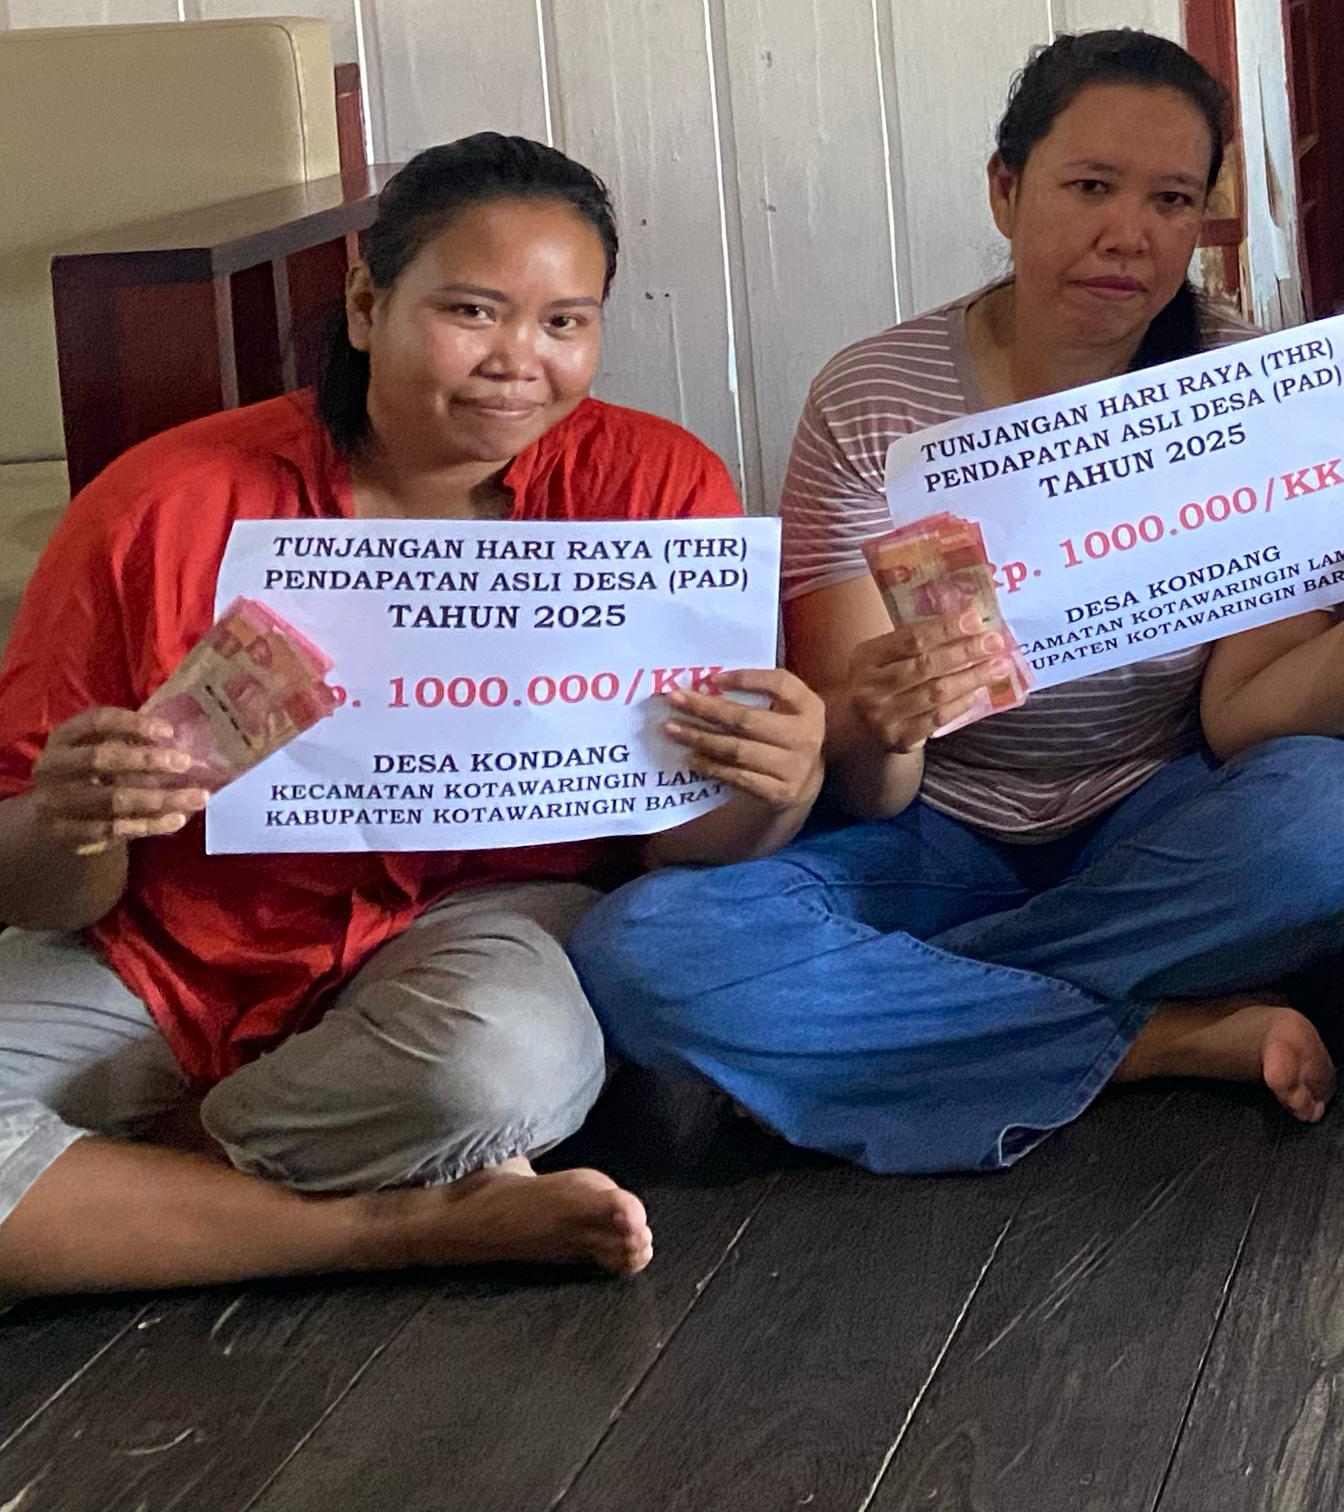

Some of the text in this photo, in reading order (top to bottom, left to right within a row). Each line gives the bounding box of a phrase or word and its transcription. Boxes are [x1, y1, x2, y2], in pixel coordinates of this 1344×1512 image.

[920, 337, 1333, 463] TUNJANGAN HARI RAYA (THR)
[923, 364, 1342, 493] PENDAPATAN ASLI DESA (PAD)
[1038, 421, 1246, 498] TAHUN 2025
[272, 536, 747, 564] TUNJANGAN HARI RAYA (THR)
[263, 567, 748, 594] PENDAPATAN ASLI DESA (PAD)
[992, 560, 1042, 593] p.
[1064, 545, 1280, 624] DESA KONDANG
[387, 603, 626, 629] TAHUN 2025
[1021, 617, 1123, 656] CAMATAN
[1130, 563, 1300, 625] KOTAWARINGIN
[1031, 637, 1118, 670] UPATEN
[1126, 584, 1296, 644] KOTAWARINGIN
[373, 744, 630, 774] DESA KONDANG
[270, 769, 718, 801] KECAMATAN KOTAWARINGIN LAM
[265, 808, 422, 826] KABUPATEN
[432, 796, 636, 824] KOTAWARINGIN
